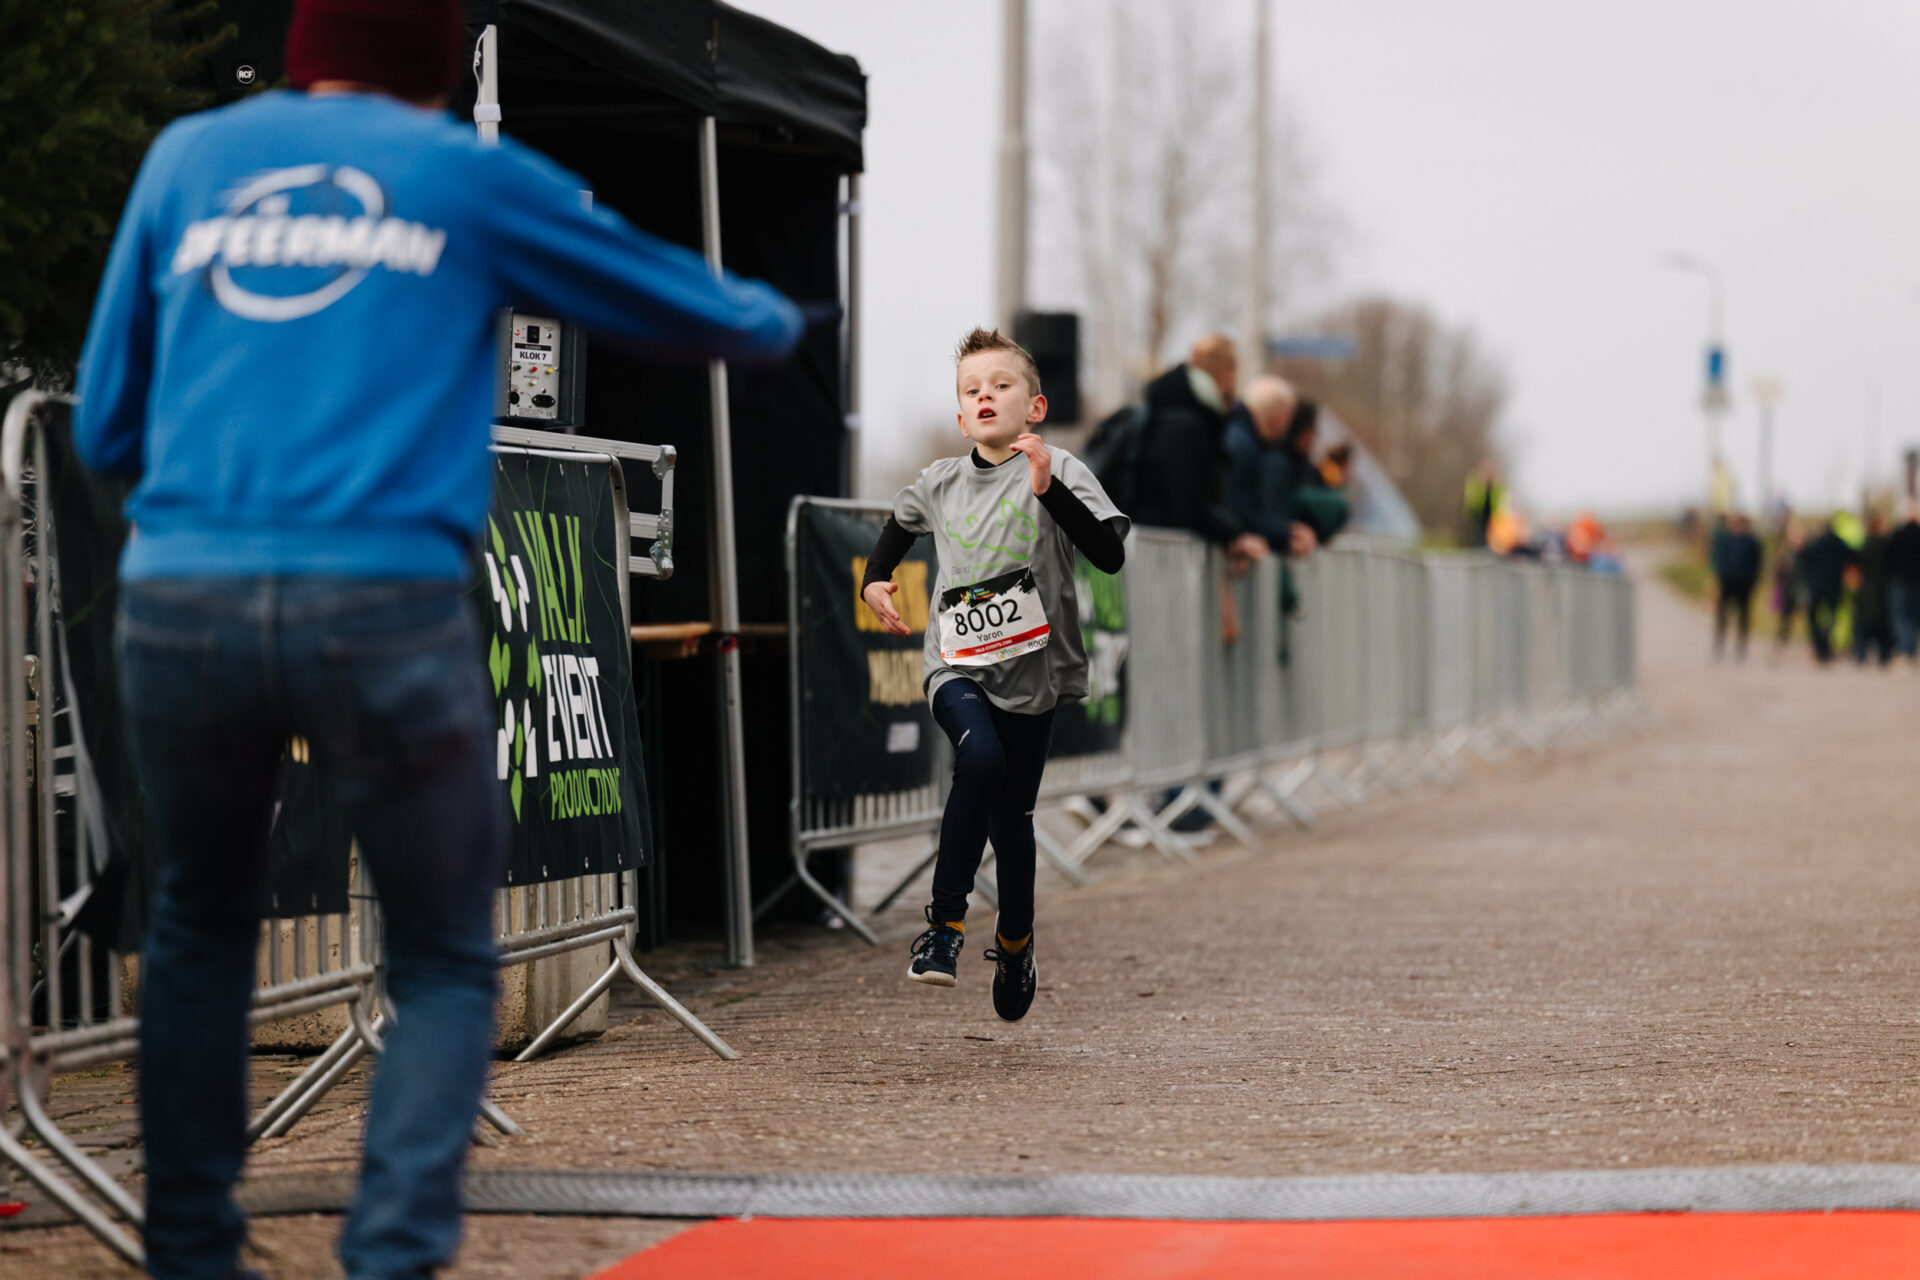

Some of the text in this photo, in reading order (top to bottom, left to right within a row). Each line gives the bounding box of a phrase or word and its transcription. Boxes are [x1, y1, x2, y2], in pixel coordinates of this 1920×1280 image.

[239, 70, 253, 79] RCF
[520, 351, 547, 361] KLOK 7
[954, 599, 1022, 636] 8002
[976, 630, 1004, 643] Yaron
[1027, 637, 1048, 650] 8002
[541, 654, 614, 763] EVENT
